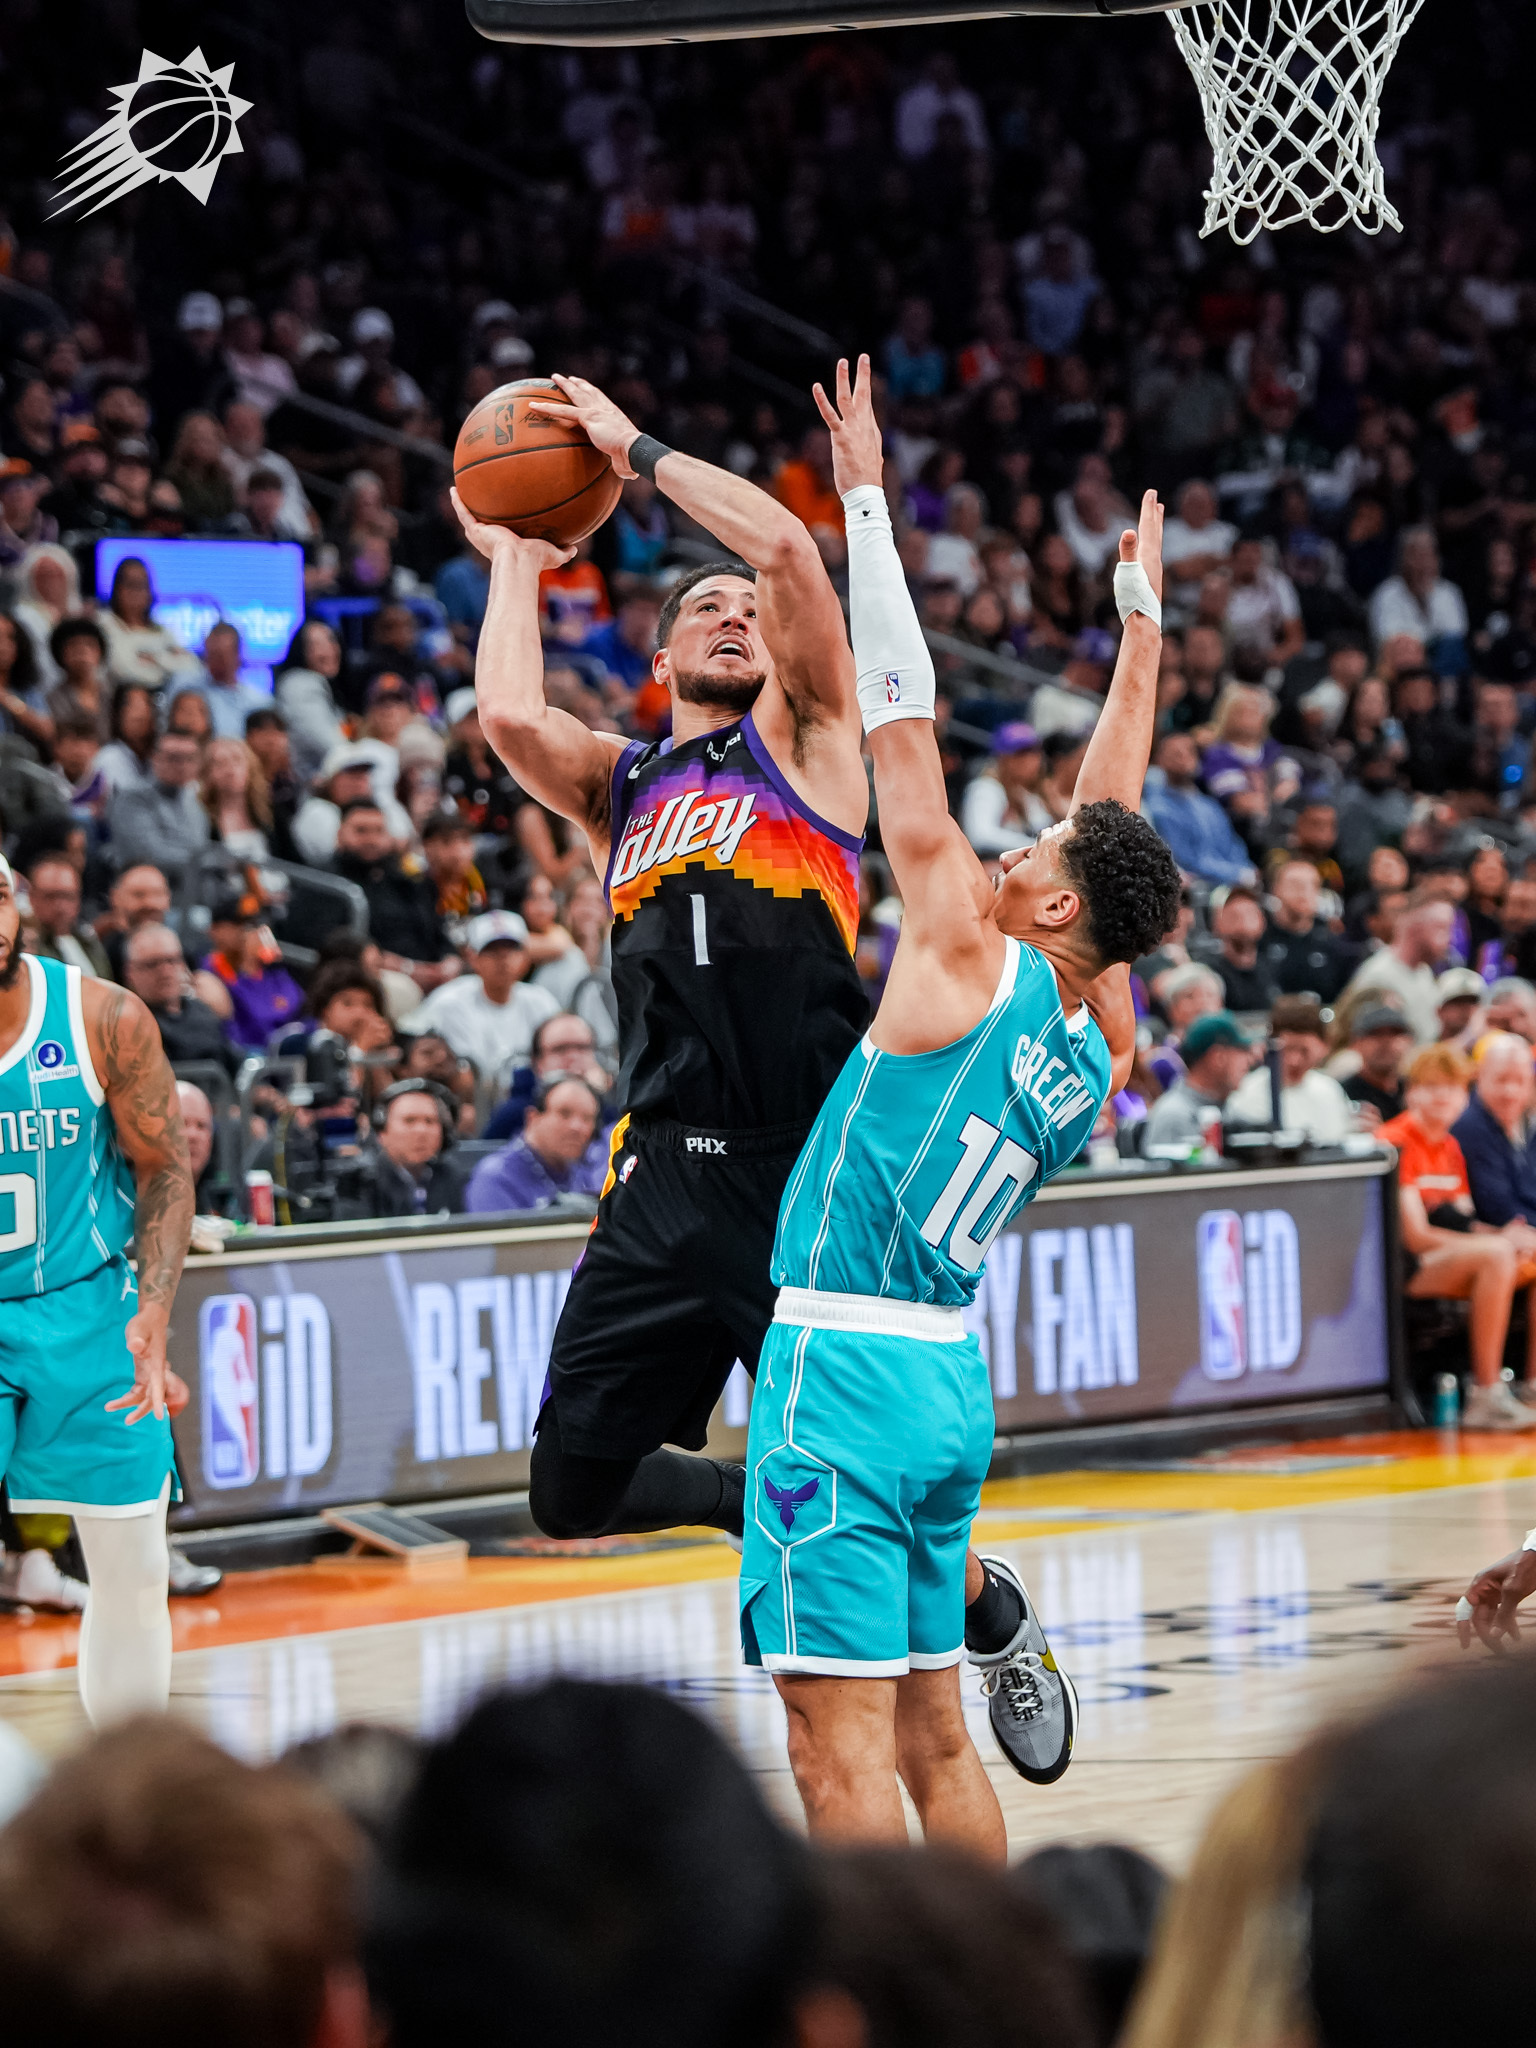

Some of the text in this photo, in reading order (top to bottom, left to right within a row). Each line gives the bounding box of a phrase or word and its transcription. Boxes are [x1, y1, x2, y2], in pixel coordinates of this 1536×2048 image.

[610, 790, 758, 889] alley
[629, 809, 657, 835] THE
[688, 893, 711, 966] 1
[1011, 1033, 1095, 1131] GREEN
[685, 1137, 728, 1155] PHX
[919, 1111, 1040, 1273] 10
[1029, 1221, 1139, 1395] FAN
